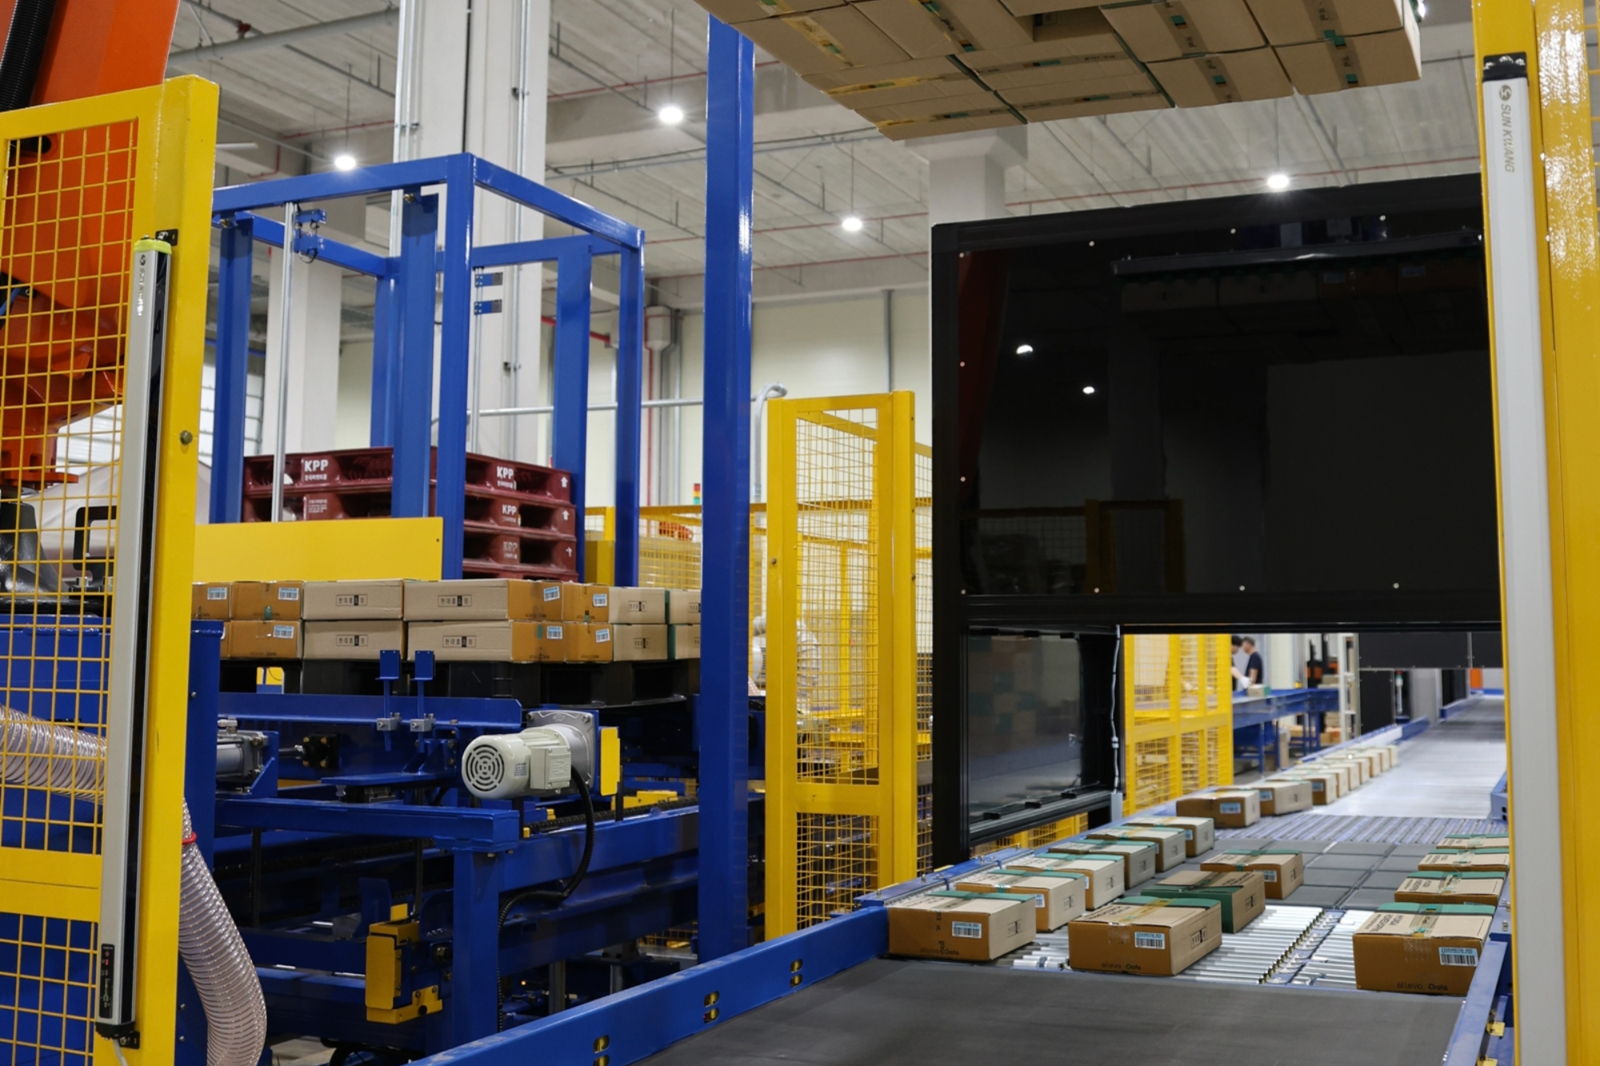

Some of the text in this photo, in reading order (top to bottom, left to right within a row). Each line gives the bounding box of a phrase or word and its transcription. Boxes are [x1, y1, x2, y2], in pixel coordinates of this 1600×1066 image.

[1501, 103, 1515, 174] SUN KWANG
[304, 459, 328, 472] KPP
[497, 466, 514, 479] KPP
[502, 504, 517, 515] KPP
